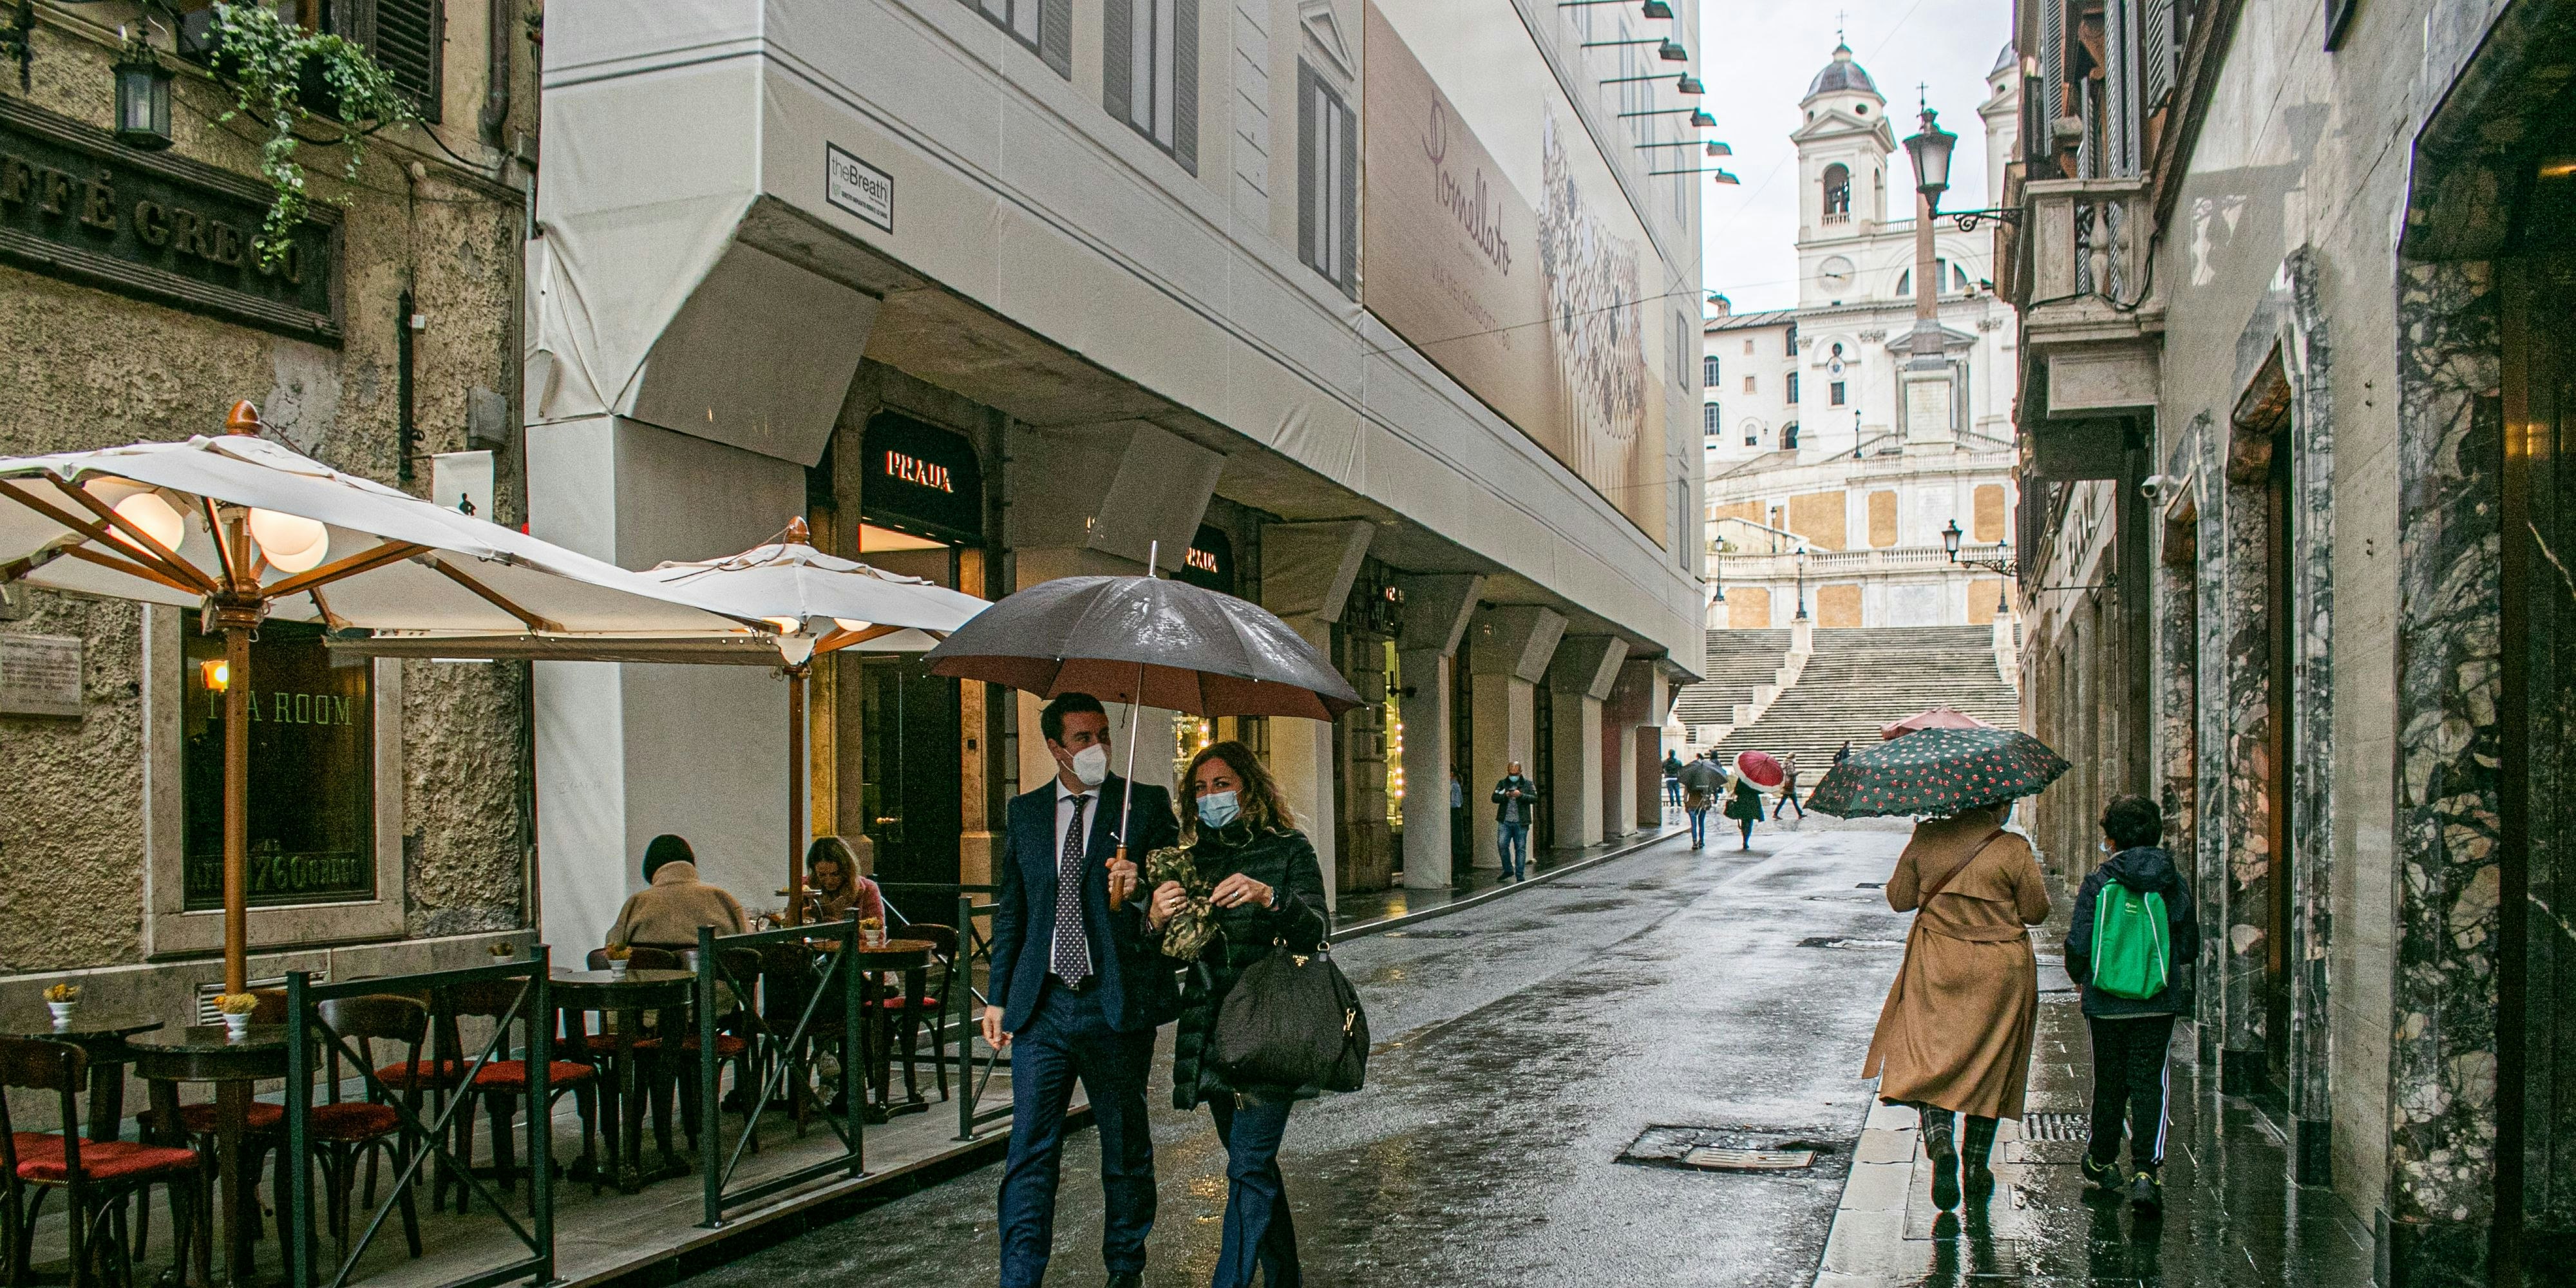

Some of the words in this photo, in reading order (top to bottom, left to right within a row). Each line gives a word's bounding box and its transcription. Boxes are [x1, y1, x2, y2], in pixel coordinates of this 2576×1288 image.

[831, 156, 887, 202] theBreath
[1422, 90, 1512, 277] Pomellato
[886, 450, 953, 493] PRADA
[1186, 547, 1218, 574] RADA
[207, 690, 262, 722] TA
[274, 692, 352, 725] ROOM
